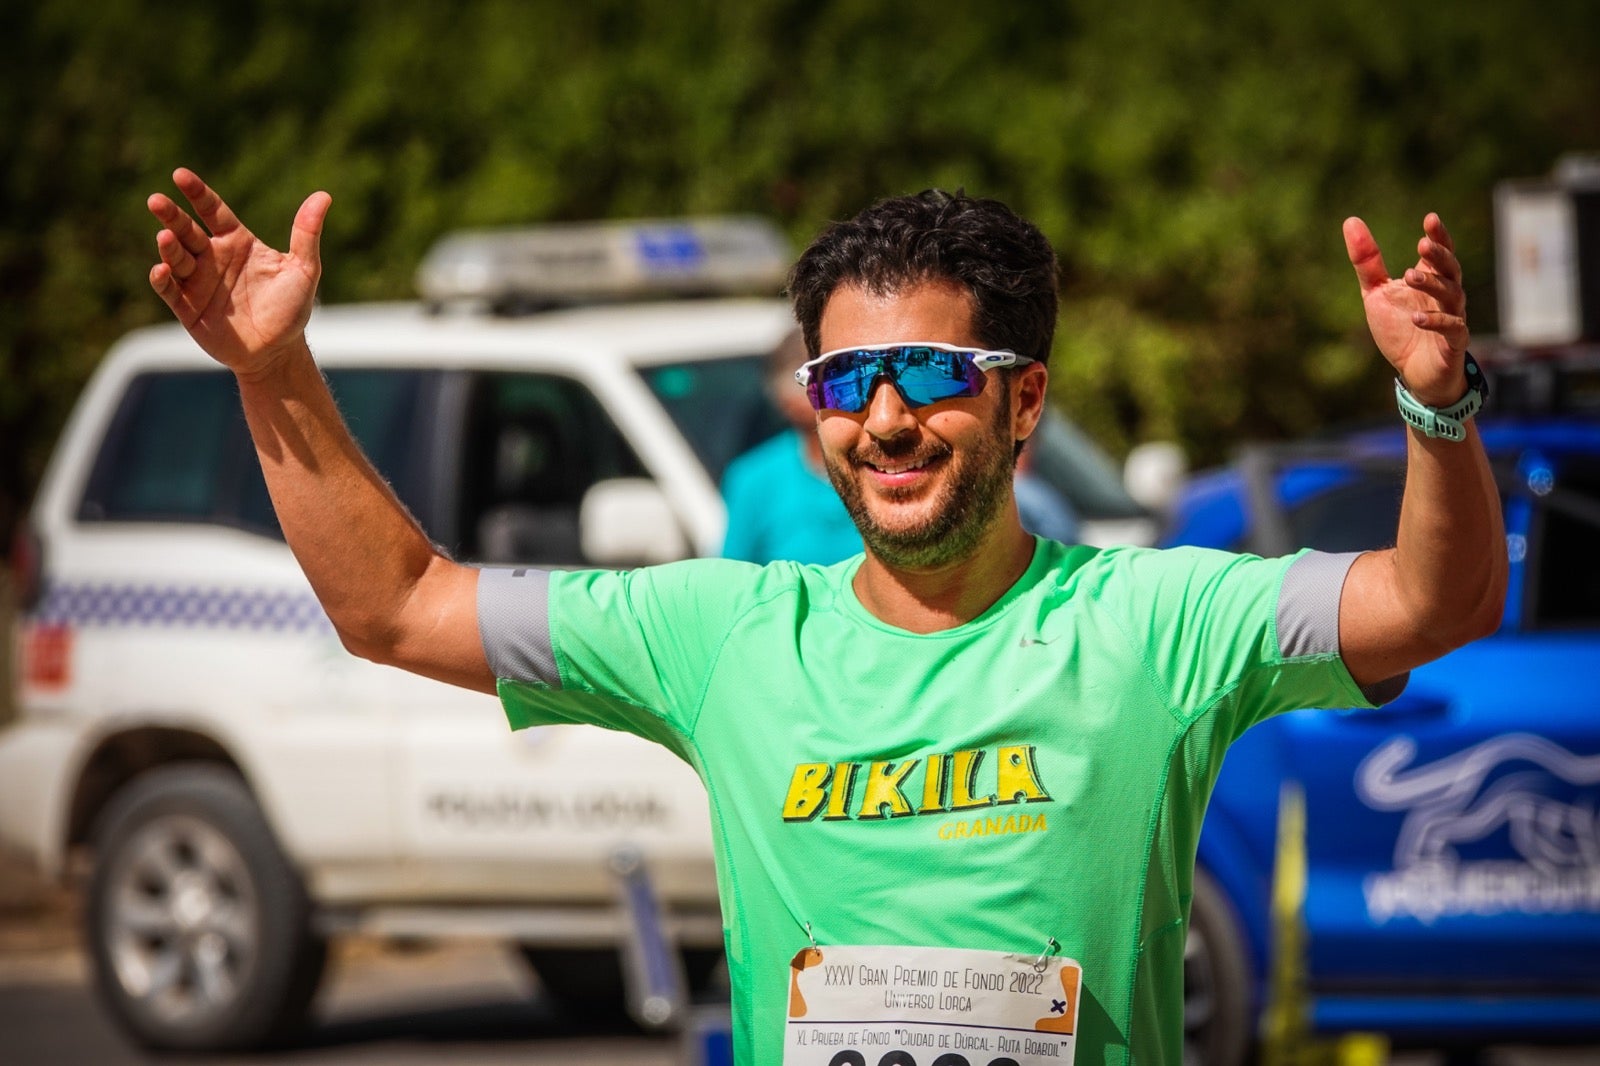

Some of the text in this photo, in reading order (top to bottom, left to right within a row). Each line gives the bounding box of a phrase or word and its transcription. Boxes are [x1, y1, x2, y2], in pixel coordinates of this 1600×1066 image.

[782, 744, 1055, 823] BIKILA
[938, 813, 1047, 840] GRANADA
[824, 964, 1044, 995] XXXV GRAN PREMIO DE FONDO 2022
[939, 992, 972, 1012] LORCA
[797, 1029, 807, 1046] XL
[997, 1035, 1020, 1054] RUTA
